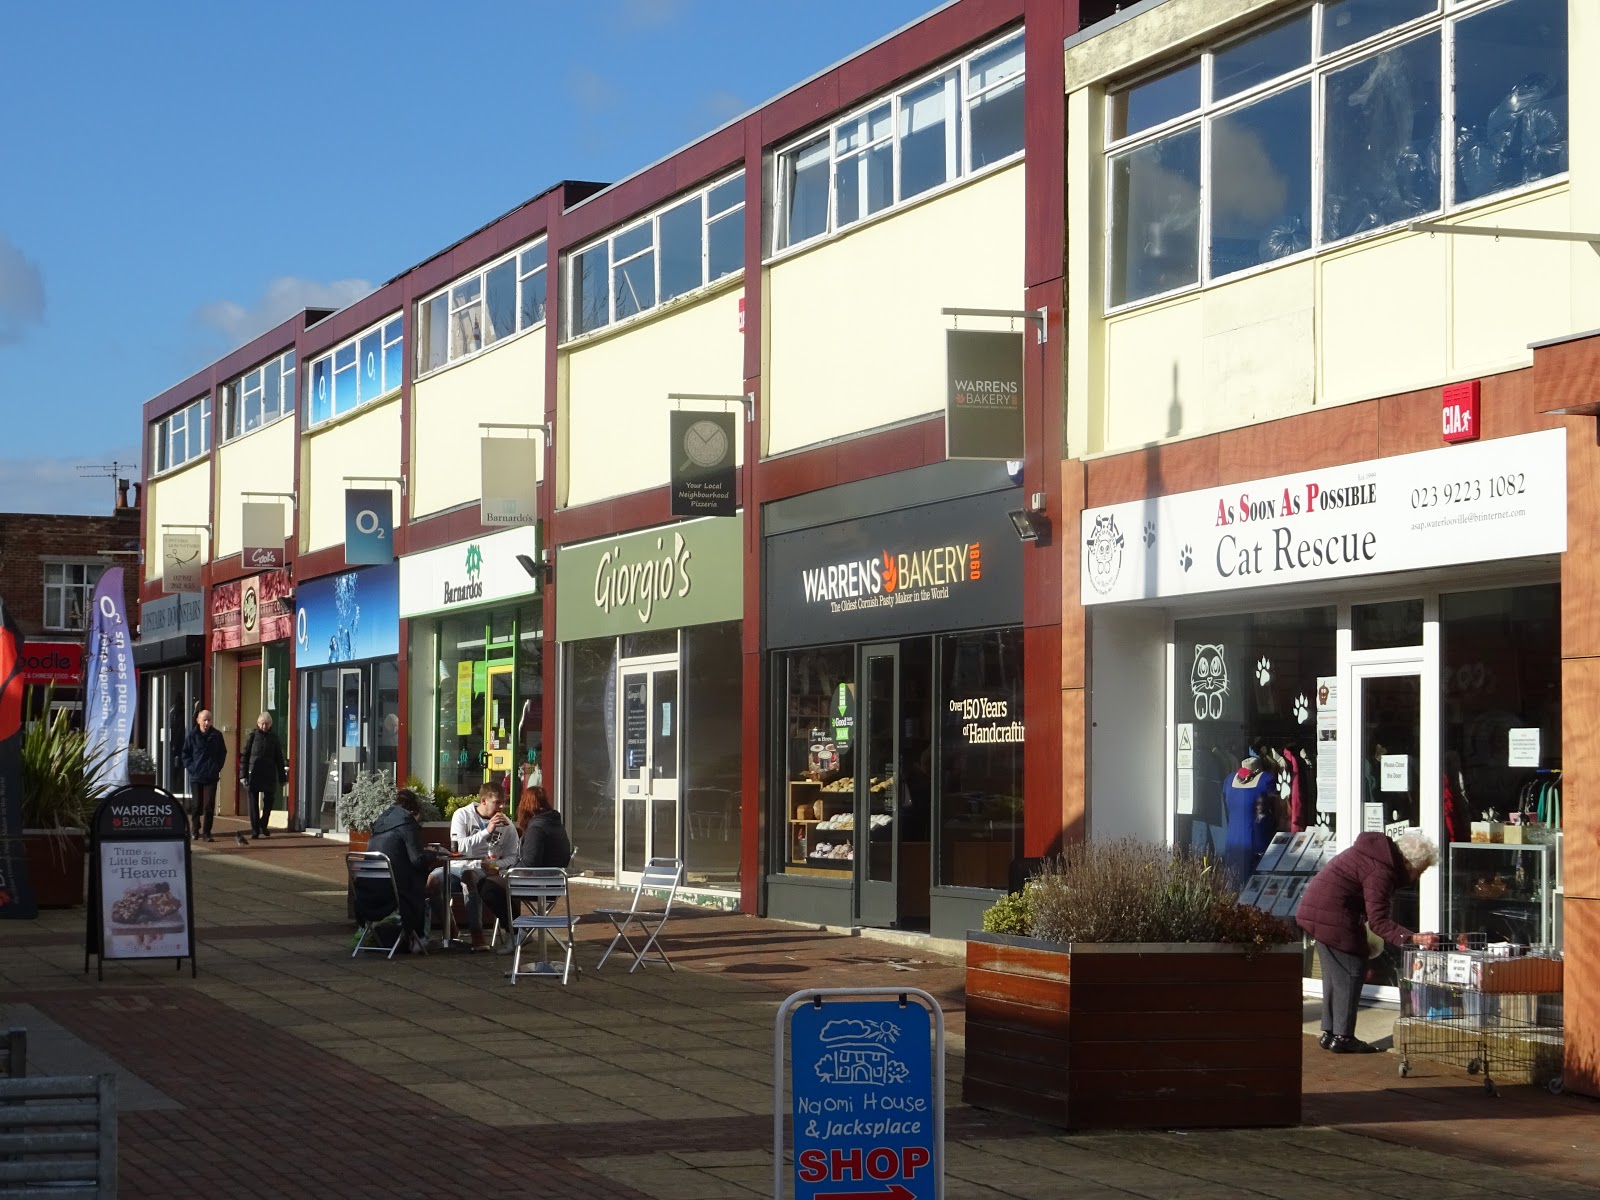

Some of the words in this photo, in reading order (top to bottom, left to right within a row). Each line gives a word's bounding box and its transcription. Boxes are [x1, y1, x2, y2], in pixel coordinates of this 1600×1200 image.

[954, 379, 1018, 393] WARRENS
[966, 393, 1011, 405] BAKERY
[1442, 404, 1462, 435] CIA
[685, 482, 703, 490] Your
[704, 482, 723, 490] Local
[1410, 486, 1439, 509] 023
[1443, 479, 1482, 505] 9223
[1488, 473, 1526, 499] 1082
[678, 491, 730, 500] Neighbourhood
[690, 500, 718, 509] Pizzeria
[486, 512, 533, 522] Barnardo's
[1216, 533, 1263, 578] Cat
[1272, 526, 1377, 572] Rescue
[594, 532, 692, 624] Giorgio's
[802, 557, 882, 604] WARRENS
[898, 543, 969, 590] BAKERY
[969, 541, 982, 581] 1860
[830, 602, 841, 613] The
[841, 599, 858, 612] Oldest
[858, 596, 879, 610] Cornish
[879, 594, 895, 608] Pasty
[895, 591, 913, 605] Maker
[913, 591, 920, 602] in
[920, 589, 931, 600] the
[931, 587, 950, 600] World
[115, 631, 125, 648] us
[19, 652, 72, 669] oodle
[116, 654, 127, 680] see
[99, 667, 111, 719] upgrade
[115, 684, 127, 714] and
[949, 699, 963, 712] Over
[963, 698, 980, 719] 150
[980, 697, 1007, 718] Years
[115, 718, 126, 732] in
[962, 723, 969, 736] of
[111, 804, 173, 816] WARRENS
[122, 816, 166, 827] BAKERY
[113, 847, 141, 856] Time
[109, 857, 139, 866] Little
[141, 856, 169, 866] Slice
[119, 867, 178, 879] Heaven
[798, 1096, 854, 1115] Naomi
[863, 1092, 927, 1113] House
[821, 1118, 921, 1140] Jacksplace
[798, 1146, 931, 1183] SHOP
